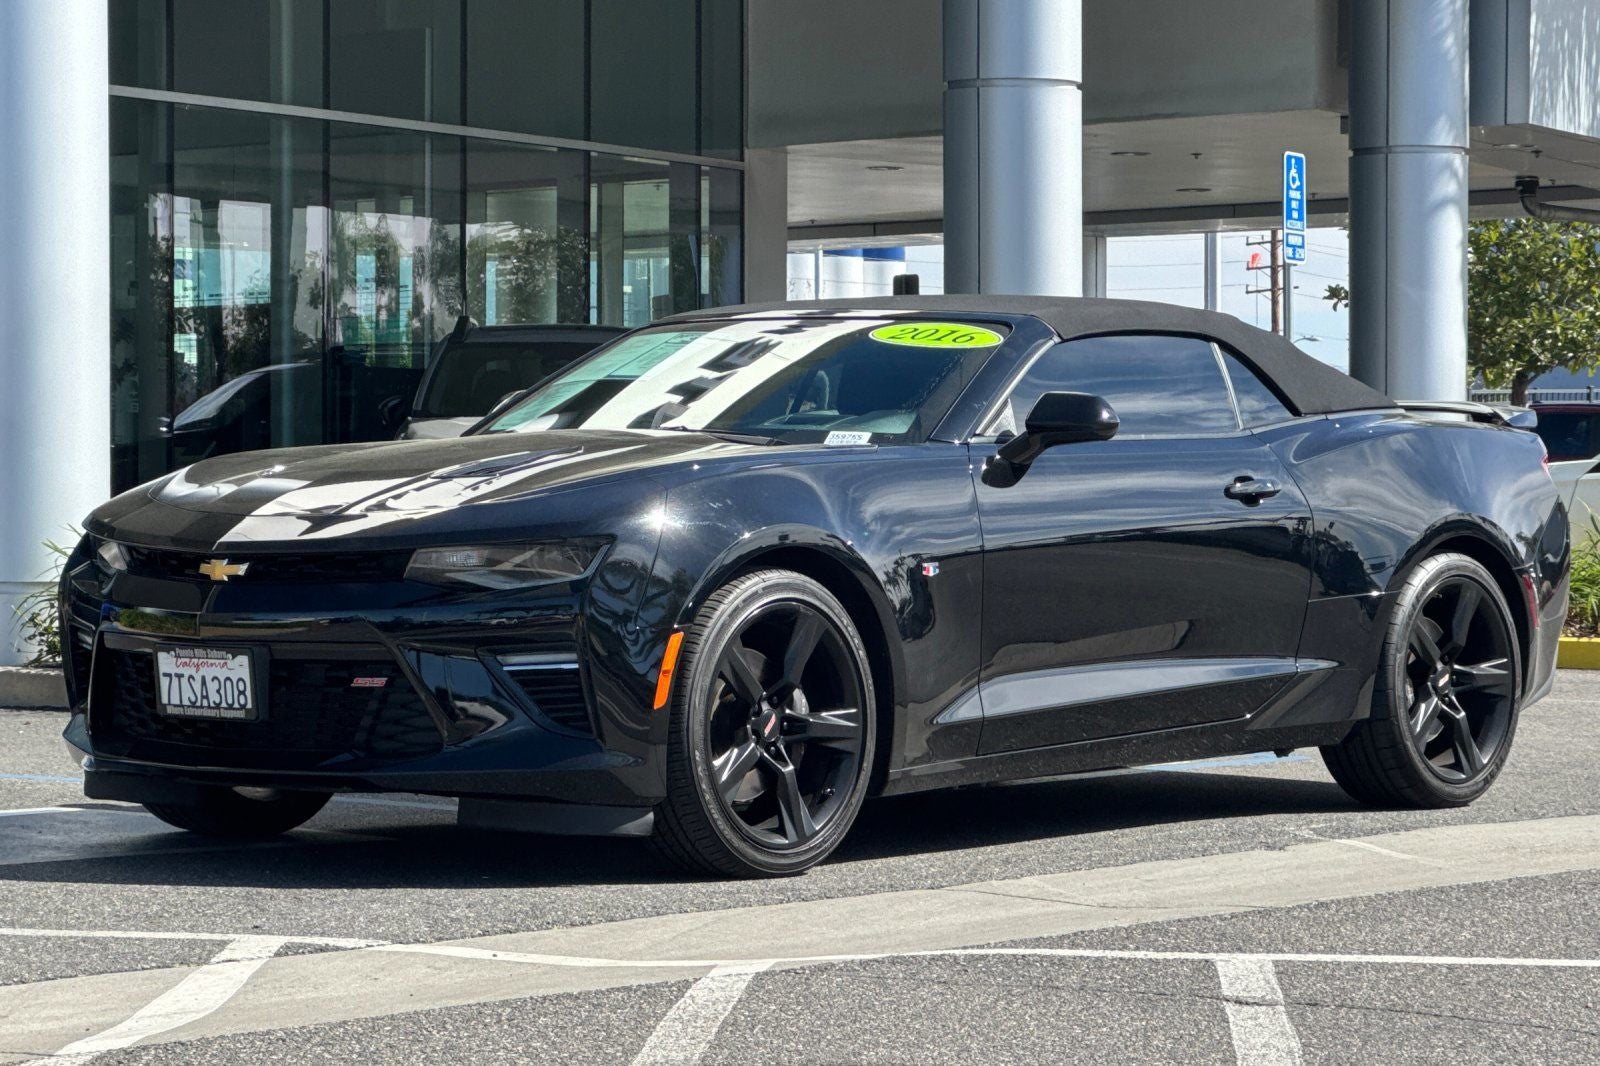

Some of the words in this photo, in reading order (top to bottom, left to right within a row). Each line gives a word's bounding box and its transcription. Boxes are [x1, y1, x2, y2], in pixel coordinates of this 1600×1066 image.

[887, 327, 986, 344] 2016
[175, 647, 194, 657] Puente
[194, 648, 207, 658] Hills
[207, 649, 227, 659] Subaru
[175, 657, 234, 673] California
[350, 677, 388, 687] SS
[162, 672, 248, 708] 7TSA308
[166, 704, 185, 714] Where
[186, 706, 219, 717] Extraordinary
